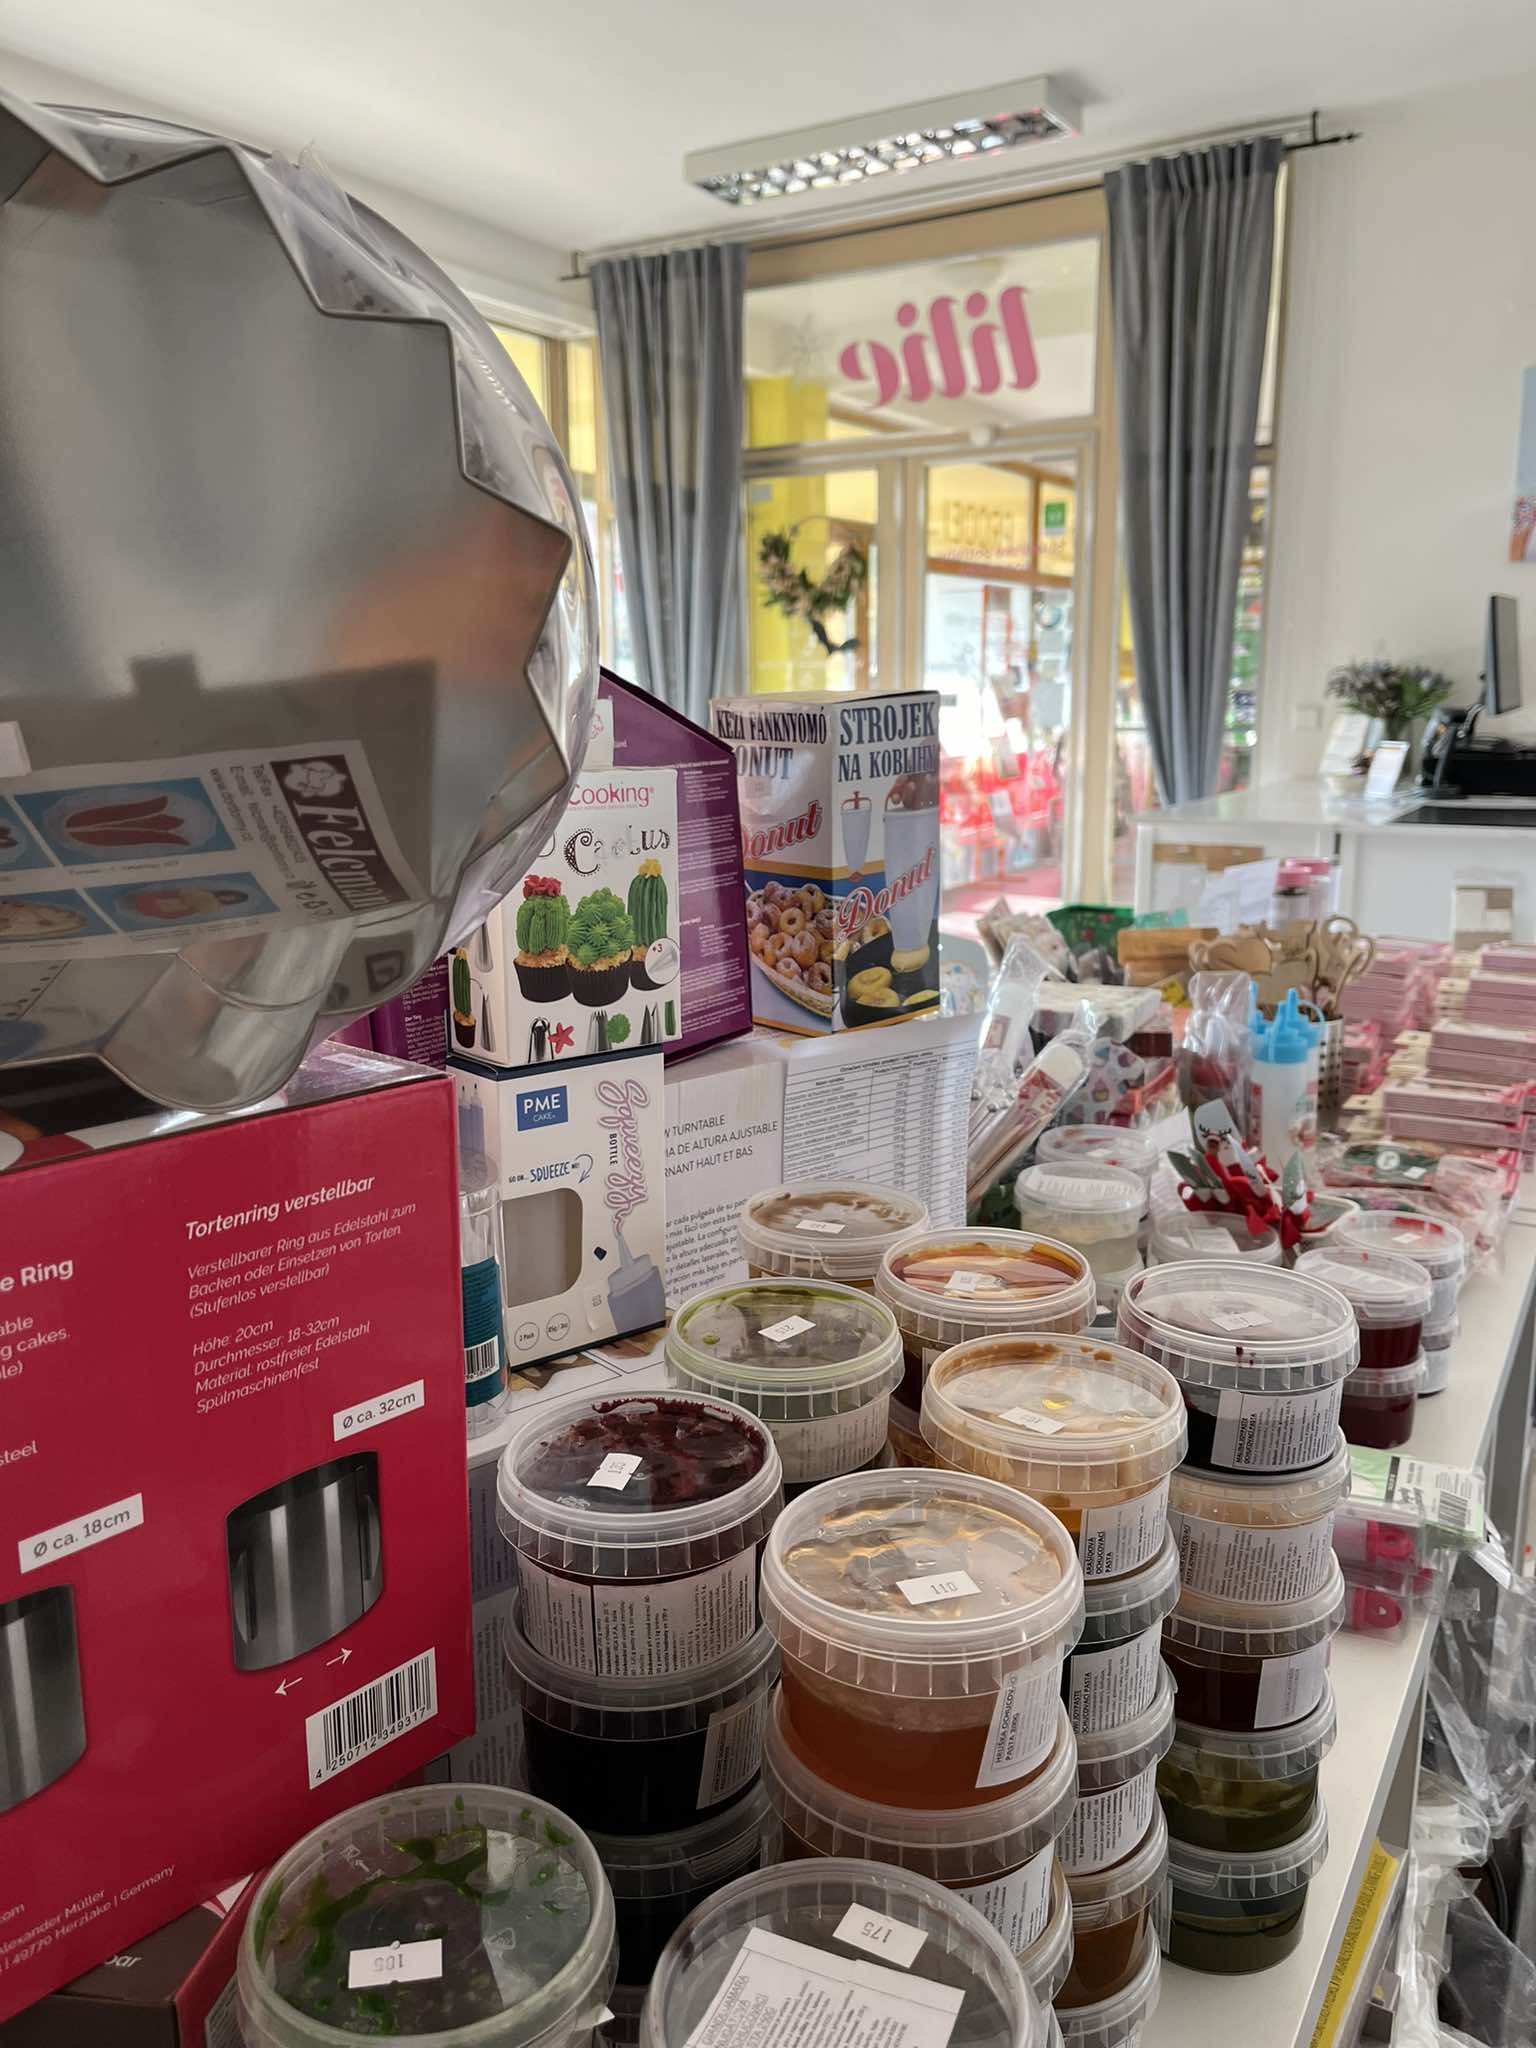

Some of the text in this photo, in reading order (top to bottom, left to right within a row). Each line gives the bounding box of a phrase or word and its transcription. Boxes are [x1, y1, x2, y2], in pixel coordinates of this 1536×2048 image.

[840, 701, 935, 747] STROJEK
[737, 745, 794, 780] ONUT
[838, 755, 862, 783] NA
[742, 801, 823, 860] onut
[838, 847, 936, 937] Donut
[523, 1094, 561, 1115] PME
[672, 1114, 727, 1138] TURNTABLE
[677, 1143, 691, 1156] DE
[692, 1135, 729, 1154] ALTURA
[730, 1120, 779, 1144] AJUSTABLE
[608, 1133, 619, 1166] BOTTLE
[664, 1145, 754, 1179] RNANT HAUT ET BAS
[530, 1161, 570, 1183] SQUEEZE
[186, 1174, 376, 1240] Tortenring verstellbar
[187, 1202, 417, 1279] Verstellbarer Ring aus Edelstahl zum
[706, 1222, 739, 1243] configura
[21, 1258, 75, 1288] Ring
[188, 1225, 402, 1299] Backen oder Einsetzen von Torten
[189, 1263, 330, 1319] (Stufenlos verstellbar)
[16, 1327, 71, 1353] cakes.
[193, 1319, 274, 1357] Höhe: 20cm
[193, 1314, 340, 1376] Durchmesser: 18-32cm
[195, 1321, 371, 1394] Material: rostfreier Edelstahl
[196, 1357, 320, 1415] Spülmaschinenfest
[355, 1406, 378, 1424] ca.
[377, 1391, 417, 1417] 32cm
[51, 1528, 81, 1551] ca.
[82, 1508, 132, 1538] 18cm
[1085, 1537, 1095, 1576] ARAŠÍDOVÁ
[1095, 1531, 1105, 1575] OCHUCOVACÍ
[1104, 1551, 1113, 1573] PASTA
[928, 1580, 959, 1598] 110
[1083, 1672, 1091, 1692] PASTA
[314, 1767, 323, 1781] 4
[329, 1735, 379, 1773] 250712
[995, 1731, 1007, 1763] HRUŠKA
[1005, 1735, 1015, 1761] PASTA
[12, 1936, 54, 1966] 49770
[54, 1902, 112, 1941] Herzlake
[119, 1865, 175, 1901] Germany
[64, 1889, 105, 1918] Müller
[859, 1919, 895, 1944] 175
[372, 1955, 407, 1973] 105
[729, 1992, 768, 2048] CHUCOVACÍ
[745, 2029, 764, 2048] STA
